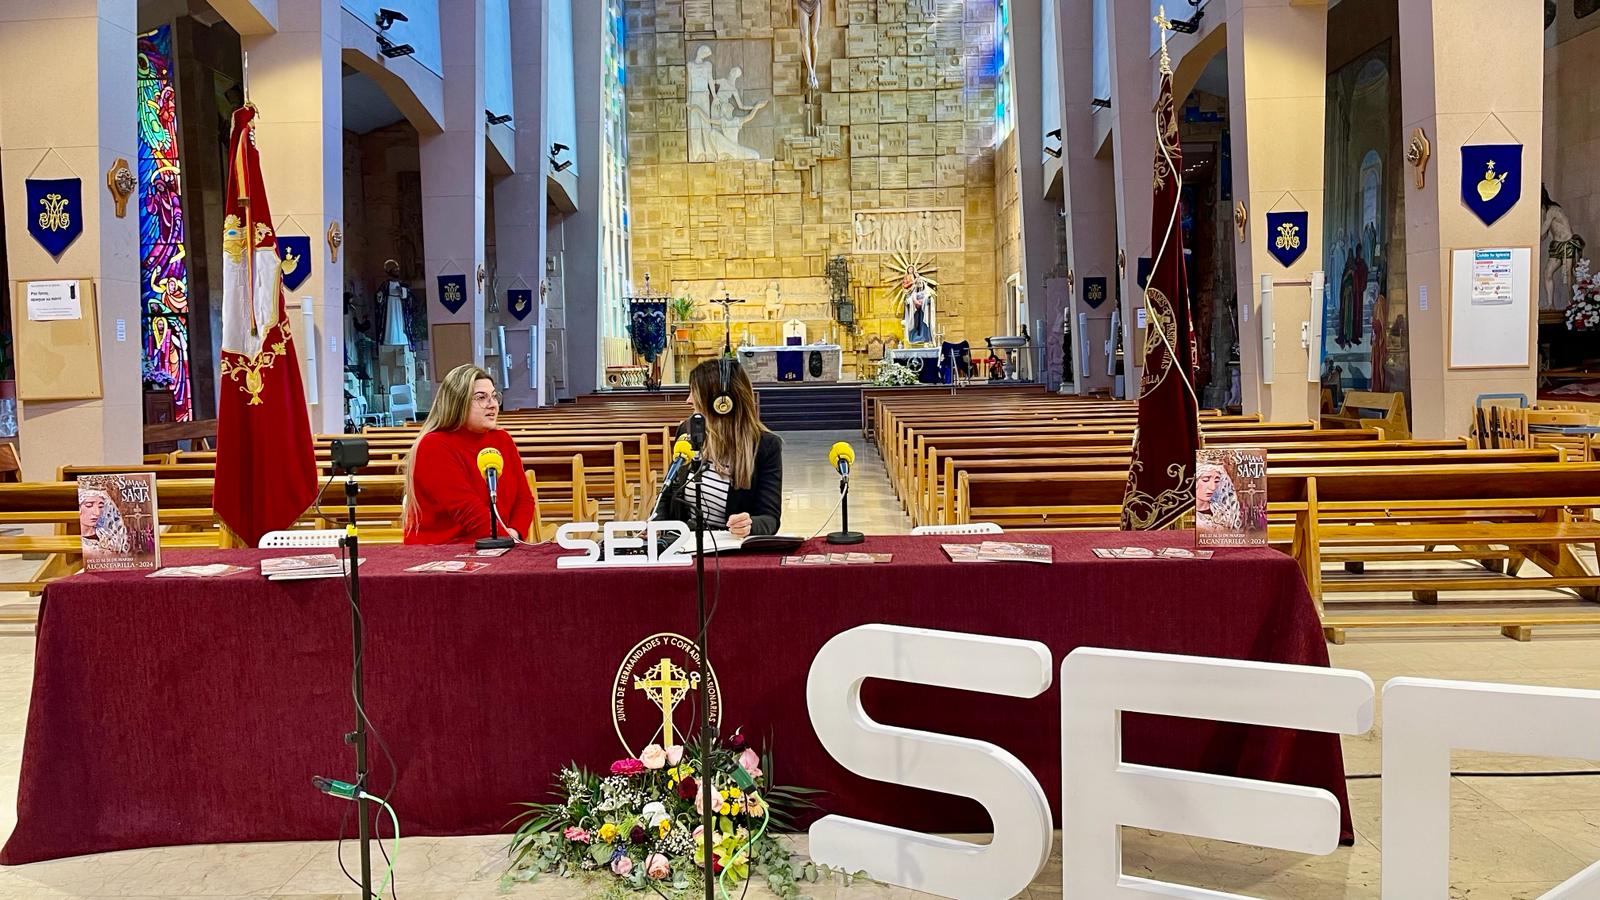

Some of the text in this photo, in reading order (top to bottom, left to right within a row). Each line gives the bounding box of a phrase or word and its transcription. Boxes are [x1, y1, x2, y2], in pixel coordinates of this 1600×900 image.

[1236, 452, 1264, 464] SEMANA
[1237, 463, 1265, 478] SANTA
[118, 476, 147, 489] SEMANA
[122, 487, 150, 502] SANTA
[556, 520, 692, 564] SER
[86, 562, 135, 570] ALCANTARILLA
[663, 637, 669, 645] Y
[620, 638, 661, 685] HERMANDADES
[617, 687, 625, 697] DE
[616, 699, 626, 722] JUNTA
